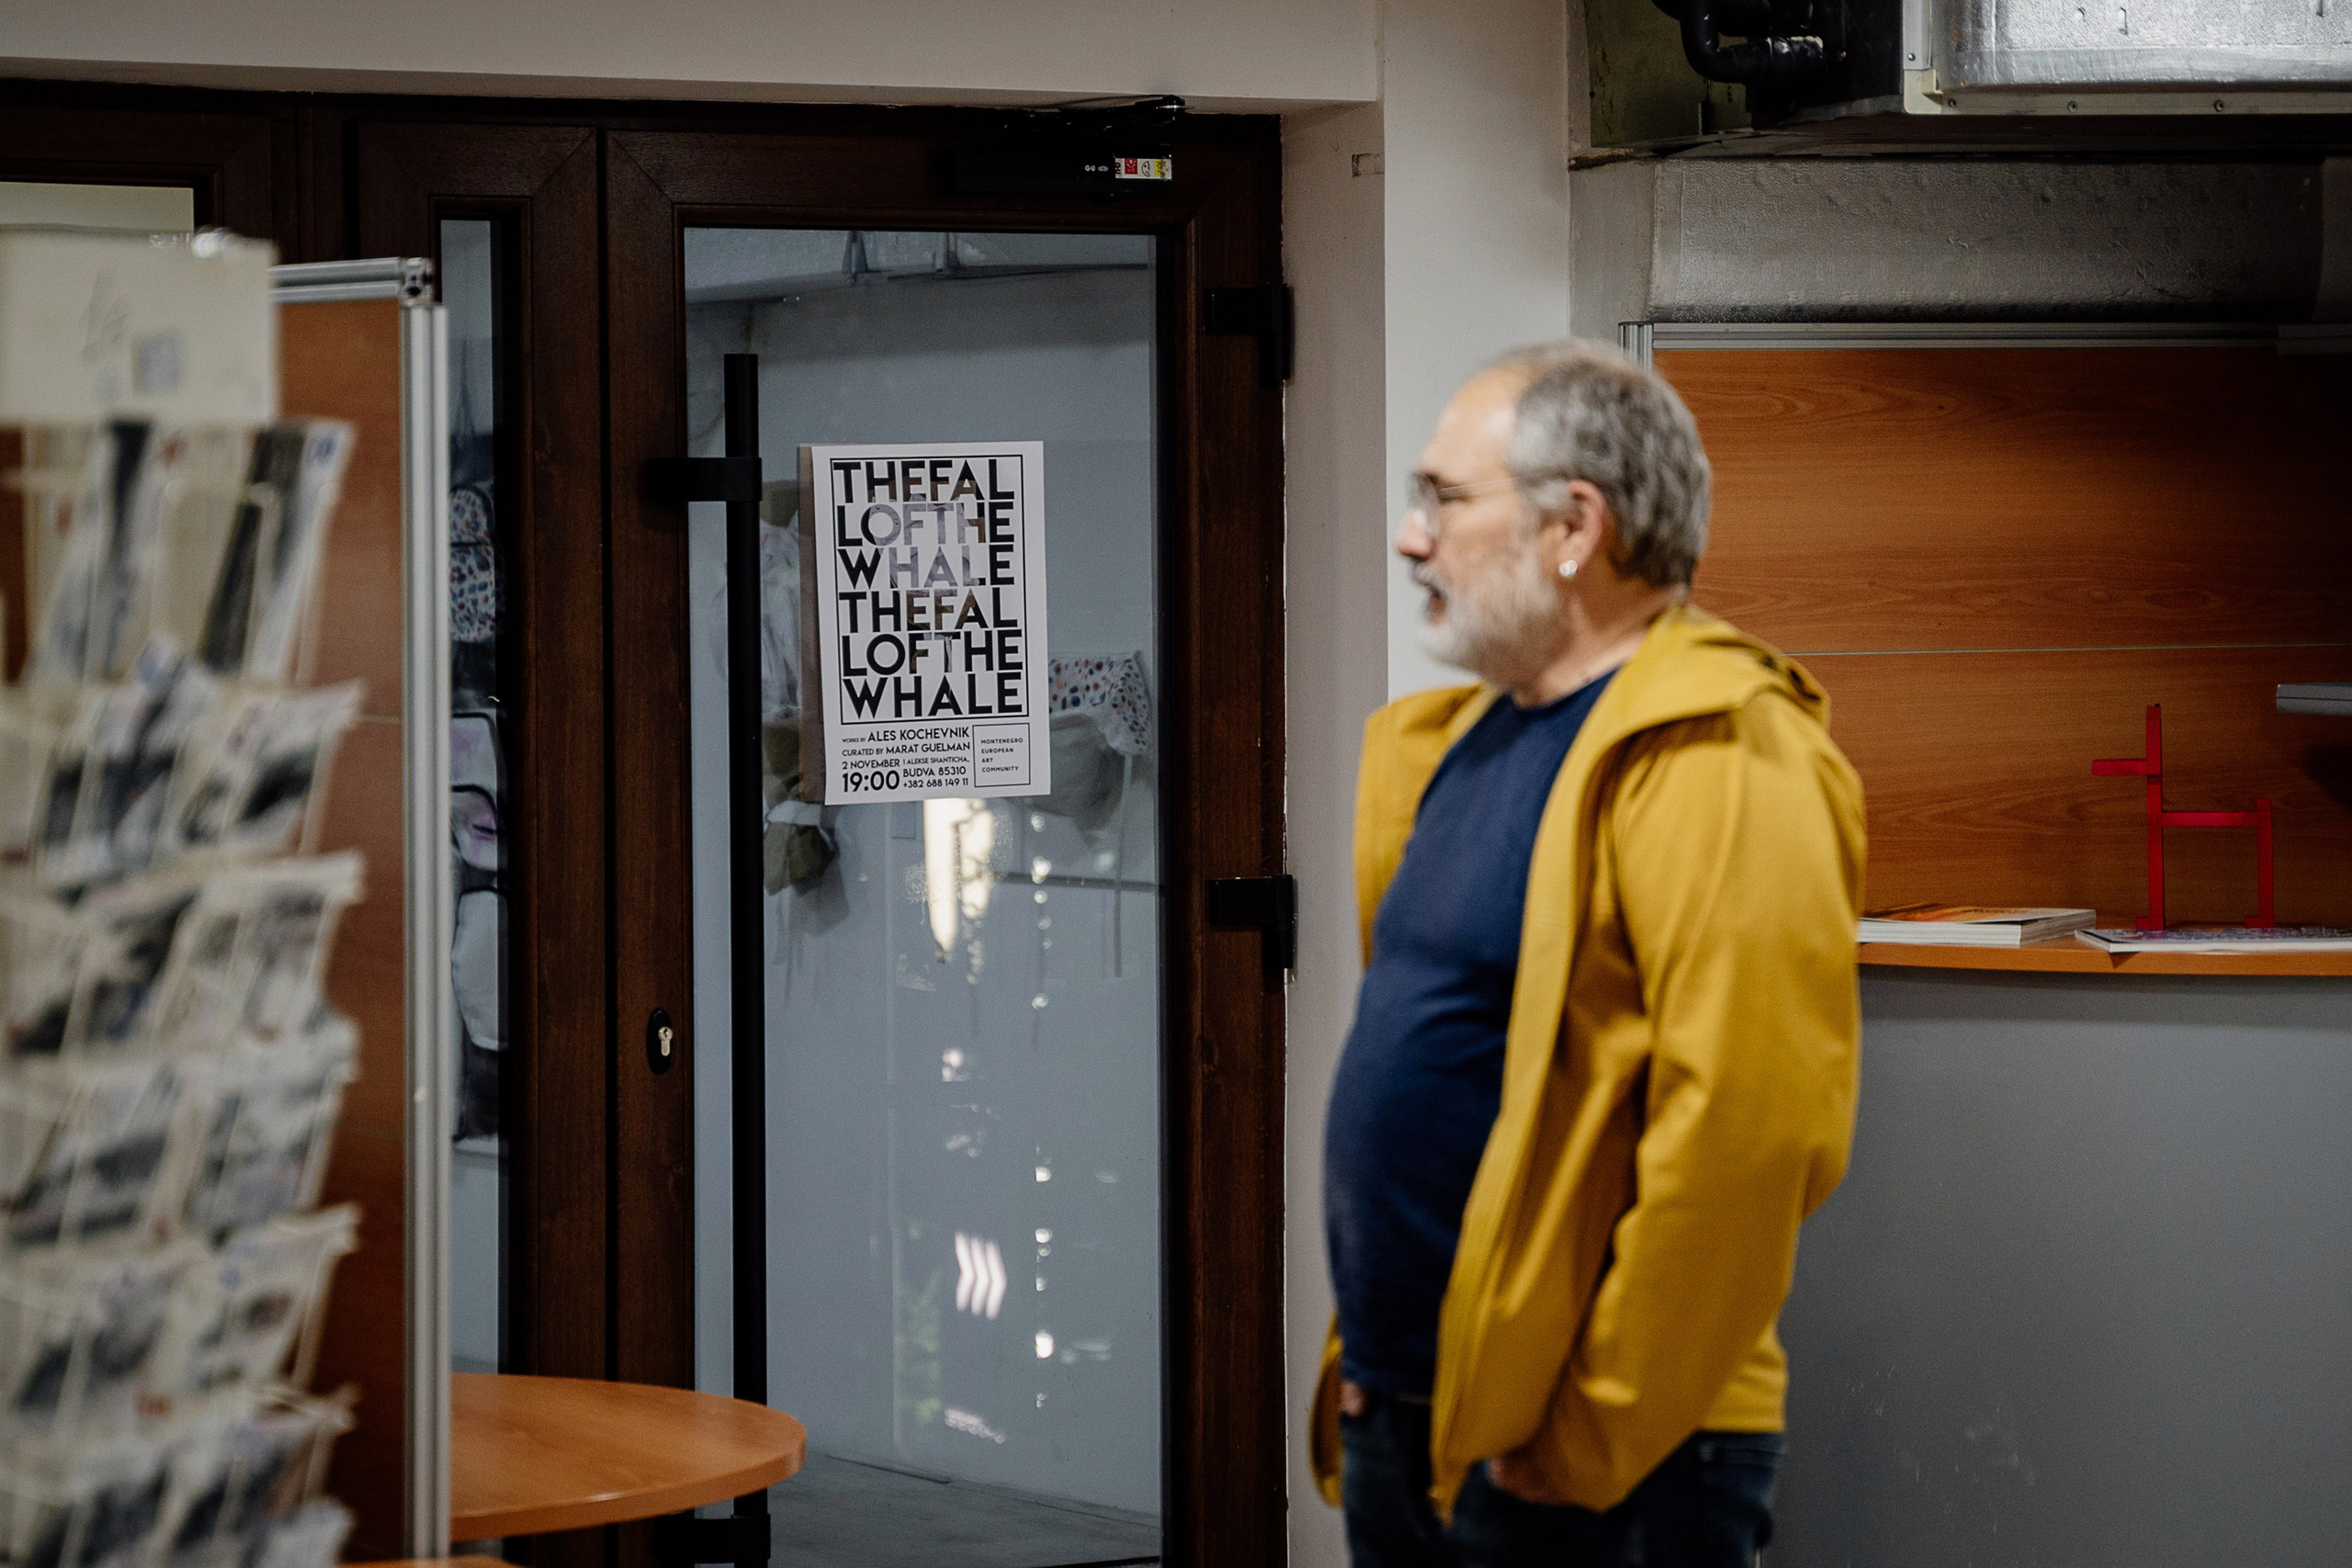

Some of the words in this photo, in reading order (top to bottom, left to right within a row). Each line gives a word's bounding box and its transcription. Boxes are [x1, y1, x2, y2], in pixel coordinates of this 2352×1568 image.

[837, 544, 1015, 591] WHALE
[842, 671, 1023, 720] WHALE
[867, 730, 897, 742] ALES
[899, 727, 970, 741] KOCHEVNIK
[842, 748, 875, 757] CURATED
[886, 743, 919, 754] MARAT
[921, 741, 970, 752] GUELMAN
[842, 761, 848, 770] 2
[850, 758, 900, 769] NOVEMBER
[906, 757, 929, 765] ALEKSE
[902, 767, 935, 778] BUDVA
[938, 766, 967, 775] 85310
[842, 770, 900, 793] 19:00
[903, 779, 924, 788] +382
[926, 779, 943, 787] 688
[944, 777, 960, 786] 149
[962, 777, 969, 785] 11
